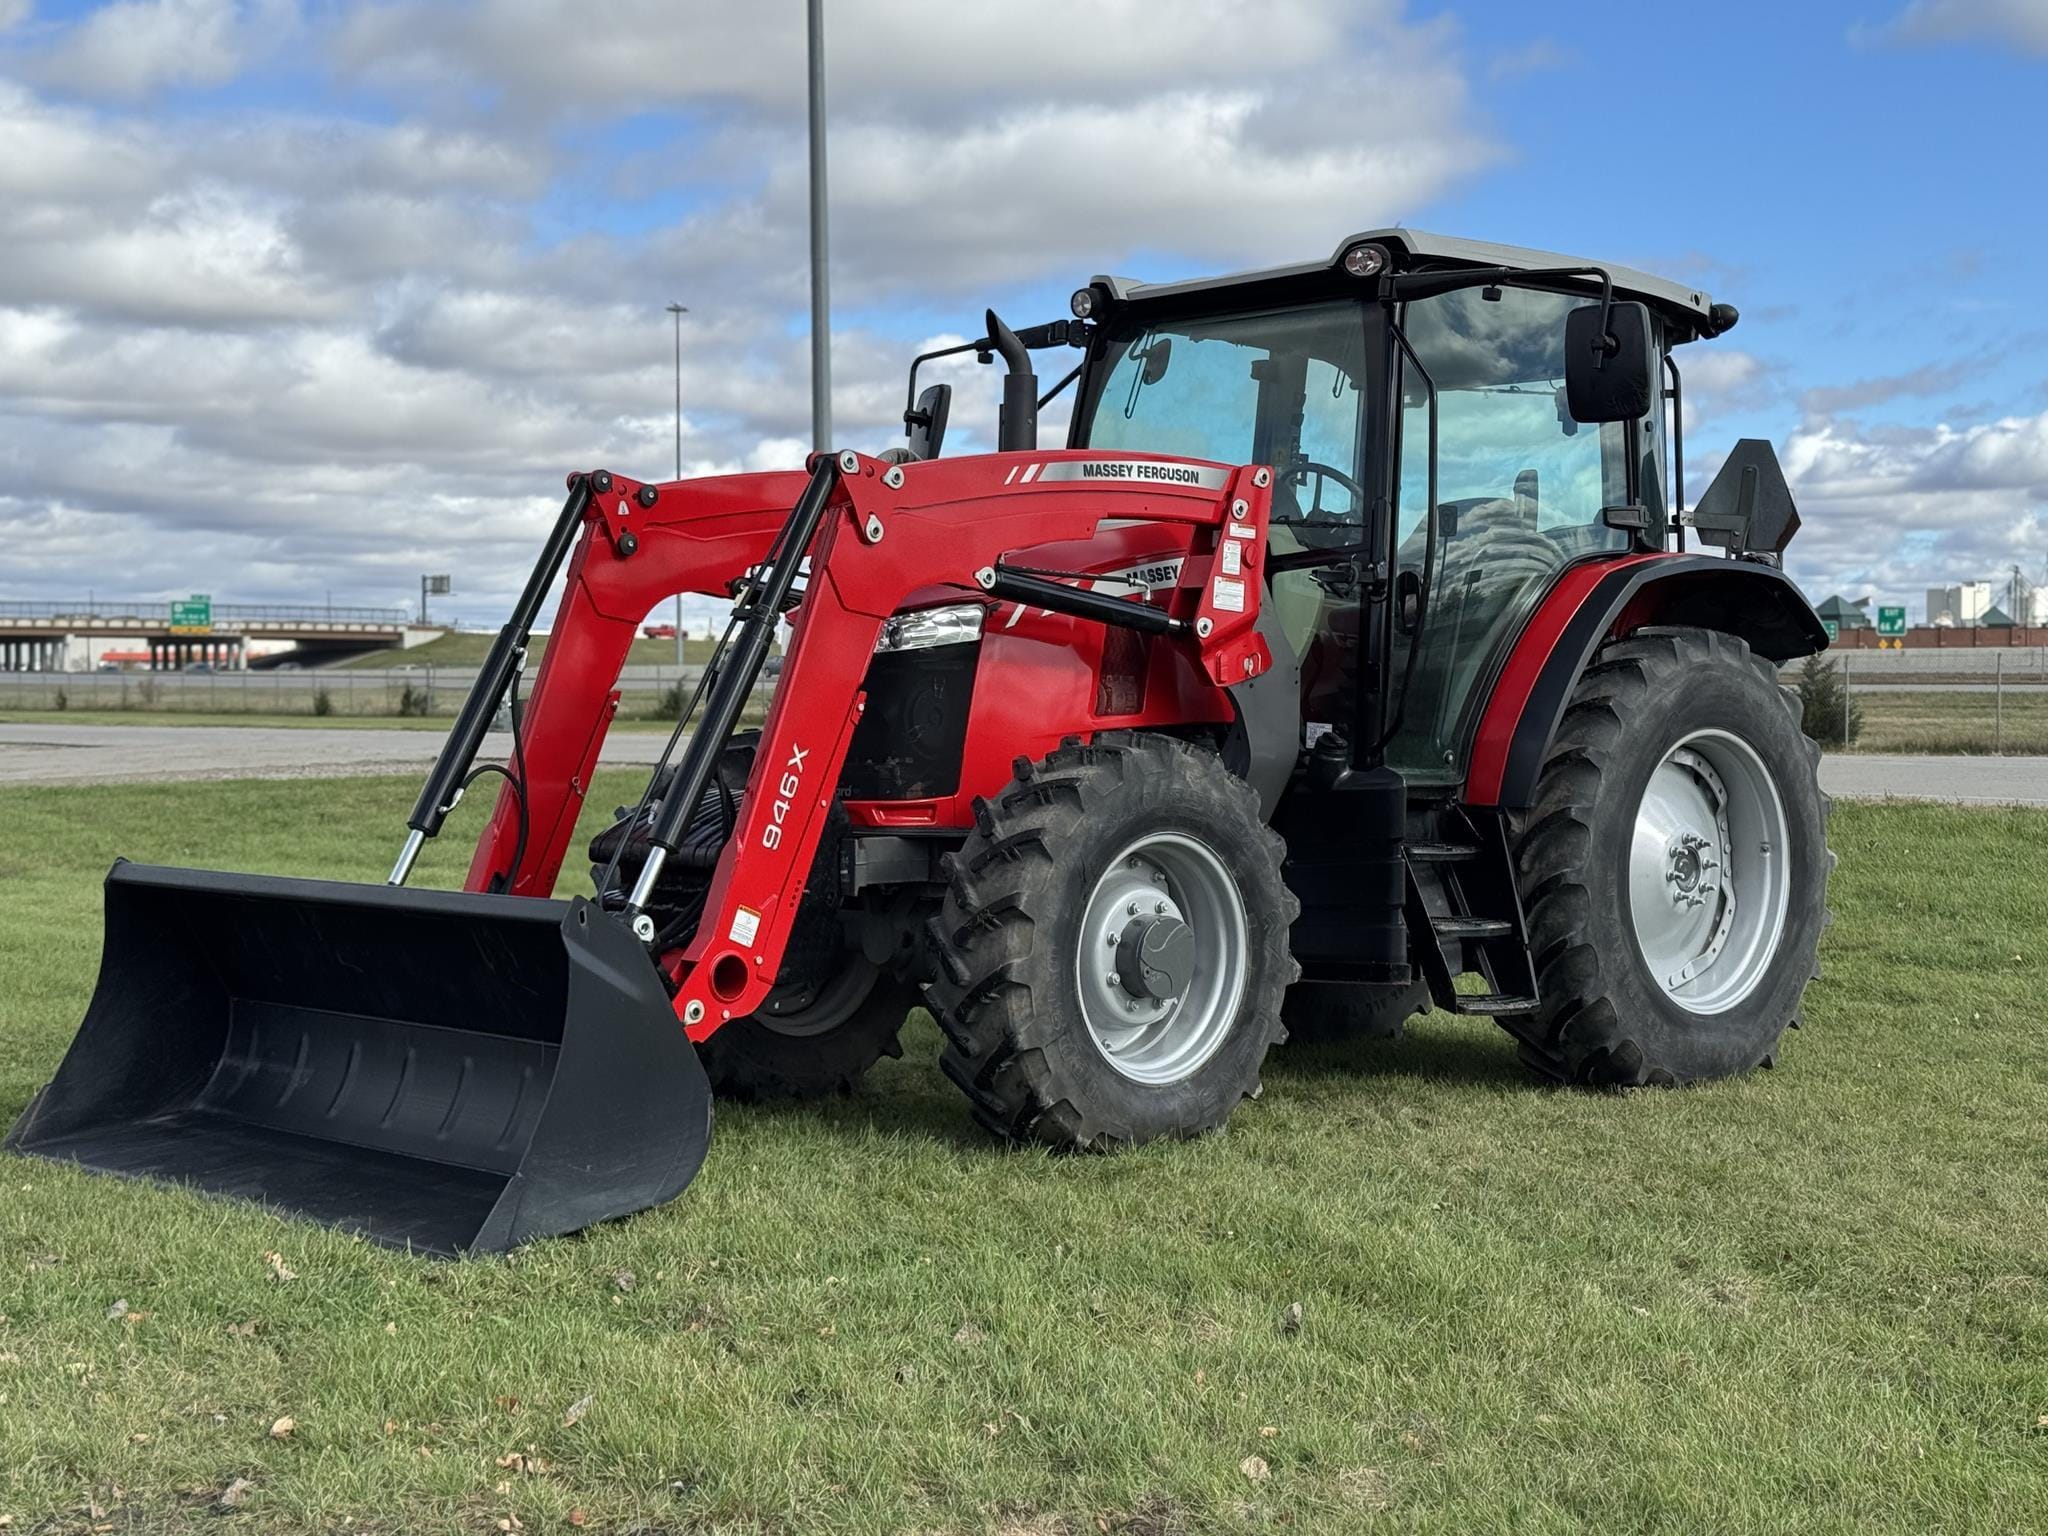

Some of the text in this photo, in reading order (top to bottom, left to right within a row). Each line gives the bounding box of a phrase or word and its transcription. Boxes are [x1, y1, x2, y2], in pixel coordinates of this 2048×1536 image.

[1083, 464, 1199, 484] MASSEY FERGUSON
[762, 742, 810, 850] 946X
